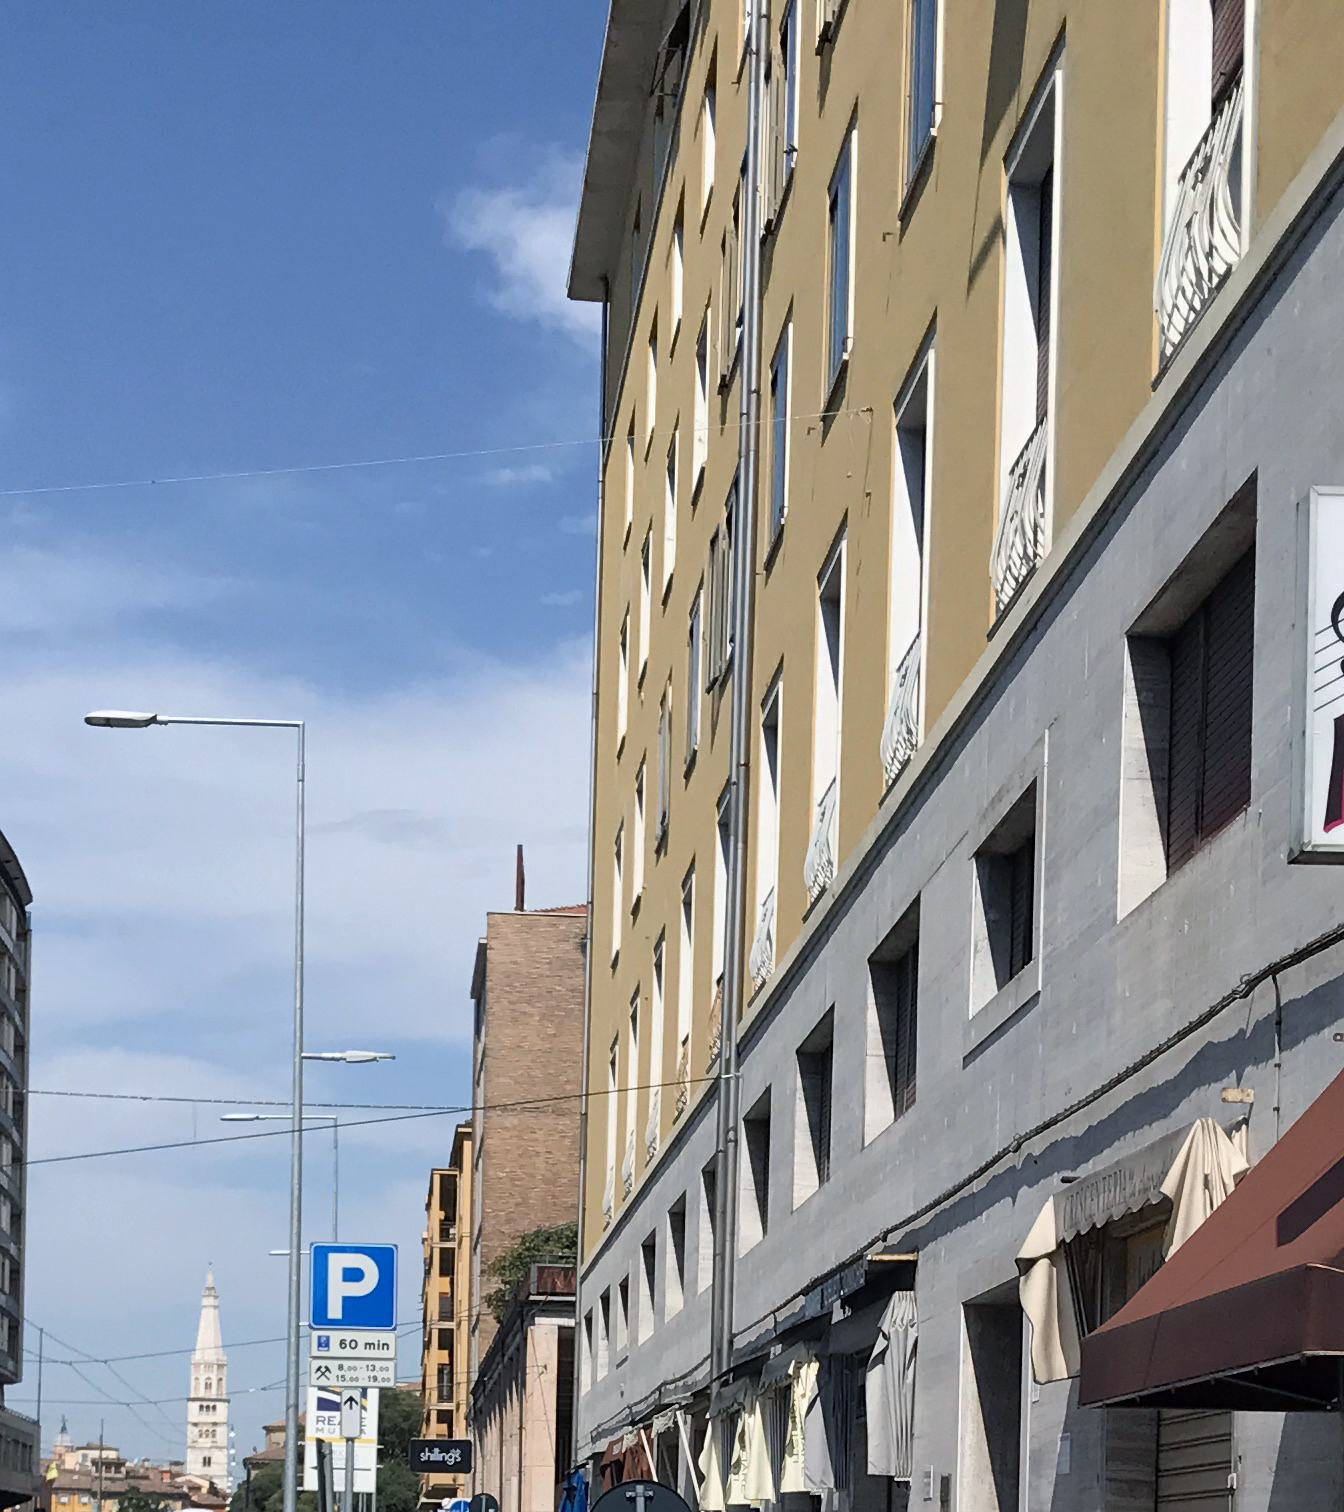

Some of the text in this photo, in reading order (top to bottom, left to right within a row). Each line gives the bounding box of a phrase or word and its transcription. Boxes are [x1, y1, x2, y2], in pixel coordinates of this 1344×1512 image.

[327, 1252, 380, 1320] P
[338, 1338, 391, 1351] 60 min
[315, 1415, 367, 1426] REE
